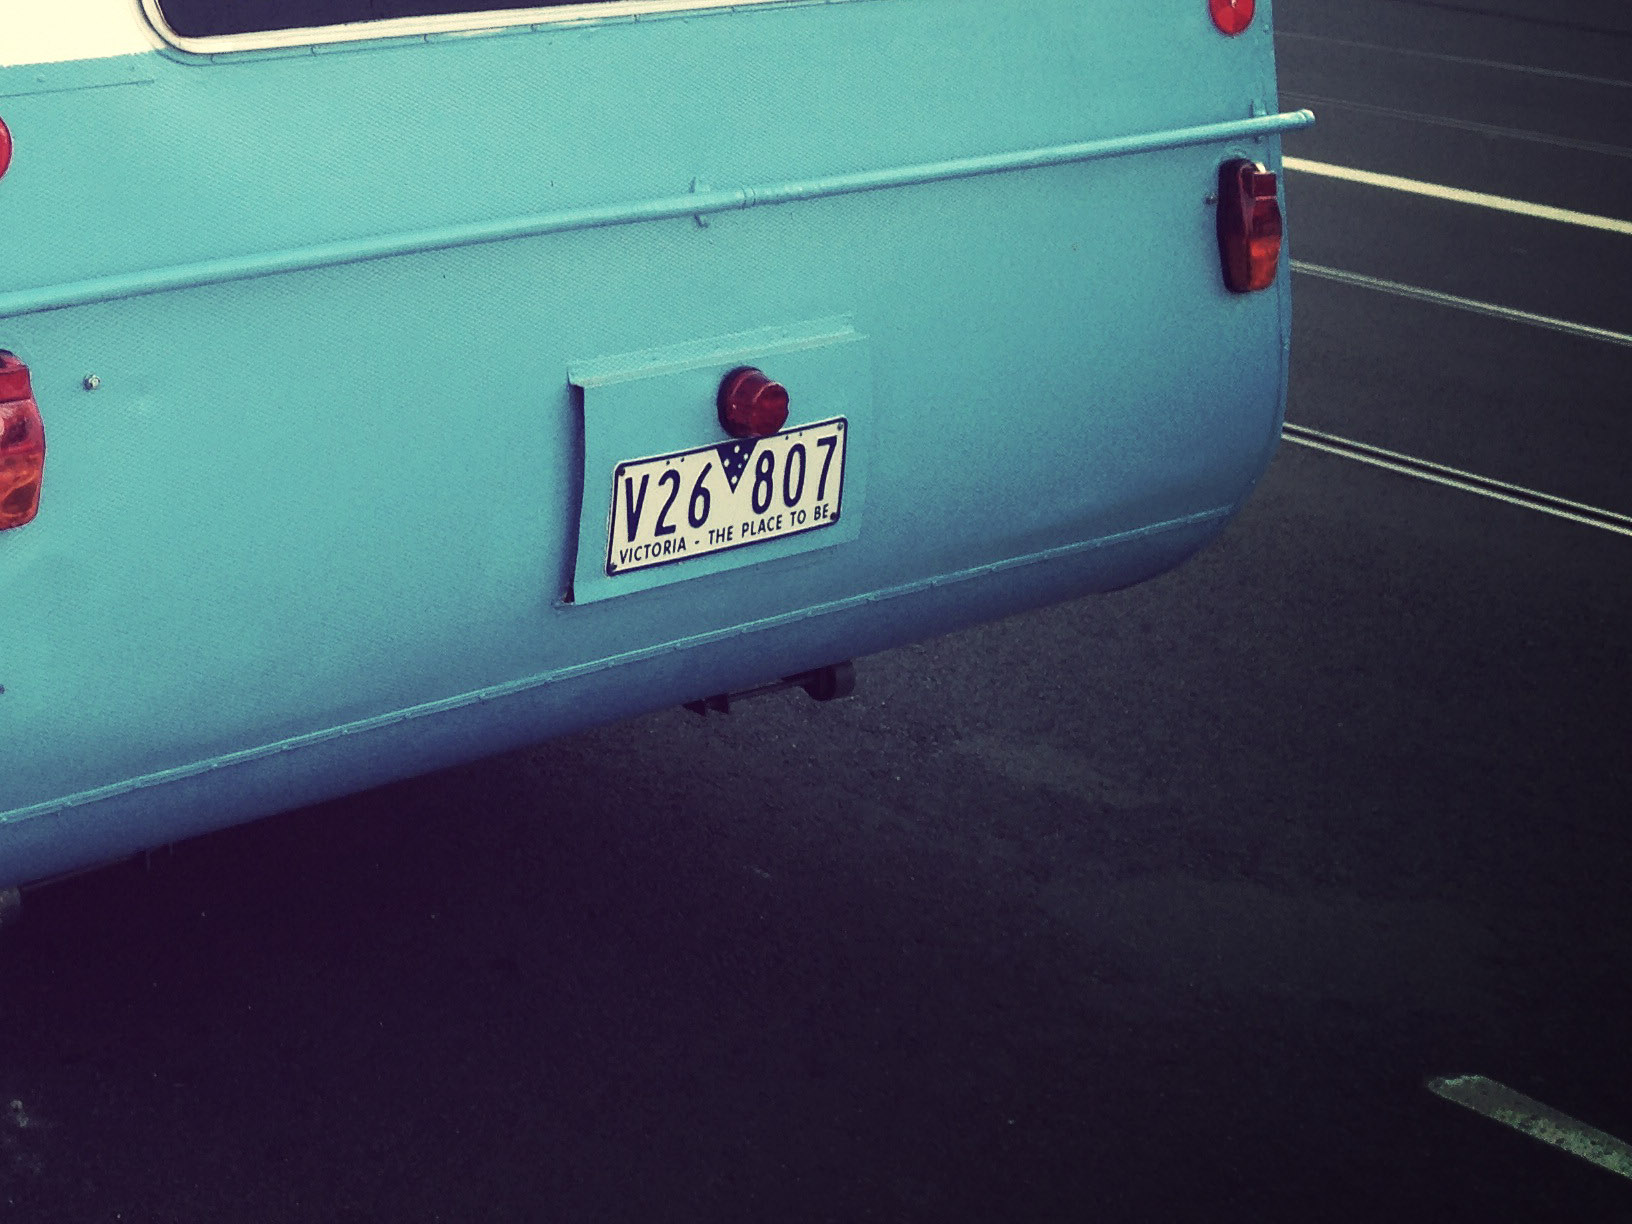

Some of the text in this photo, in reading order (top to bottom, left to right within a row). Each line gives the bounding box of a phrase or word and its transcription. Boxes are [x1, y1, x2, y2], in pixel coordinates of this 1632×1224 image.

[624, 434, 838, 543] V26 807
[619, 536, 687, 565] VICTORIA
[708, 525, 734, 545] THE
[740, 514, 783, 538] PLACE
[789, 509, 807, 528] TO
[813, 502, 830, 521] BE
